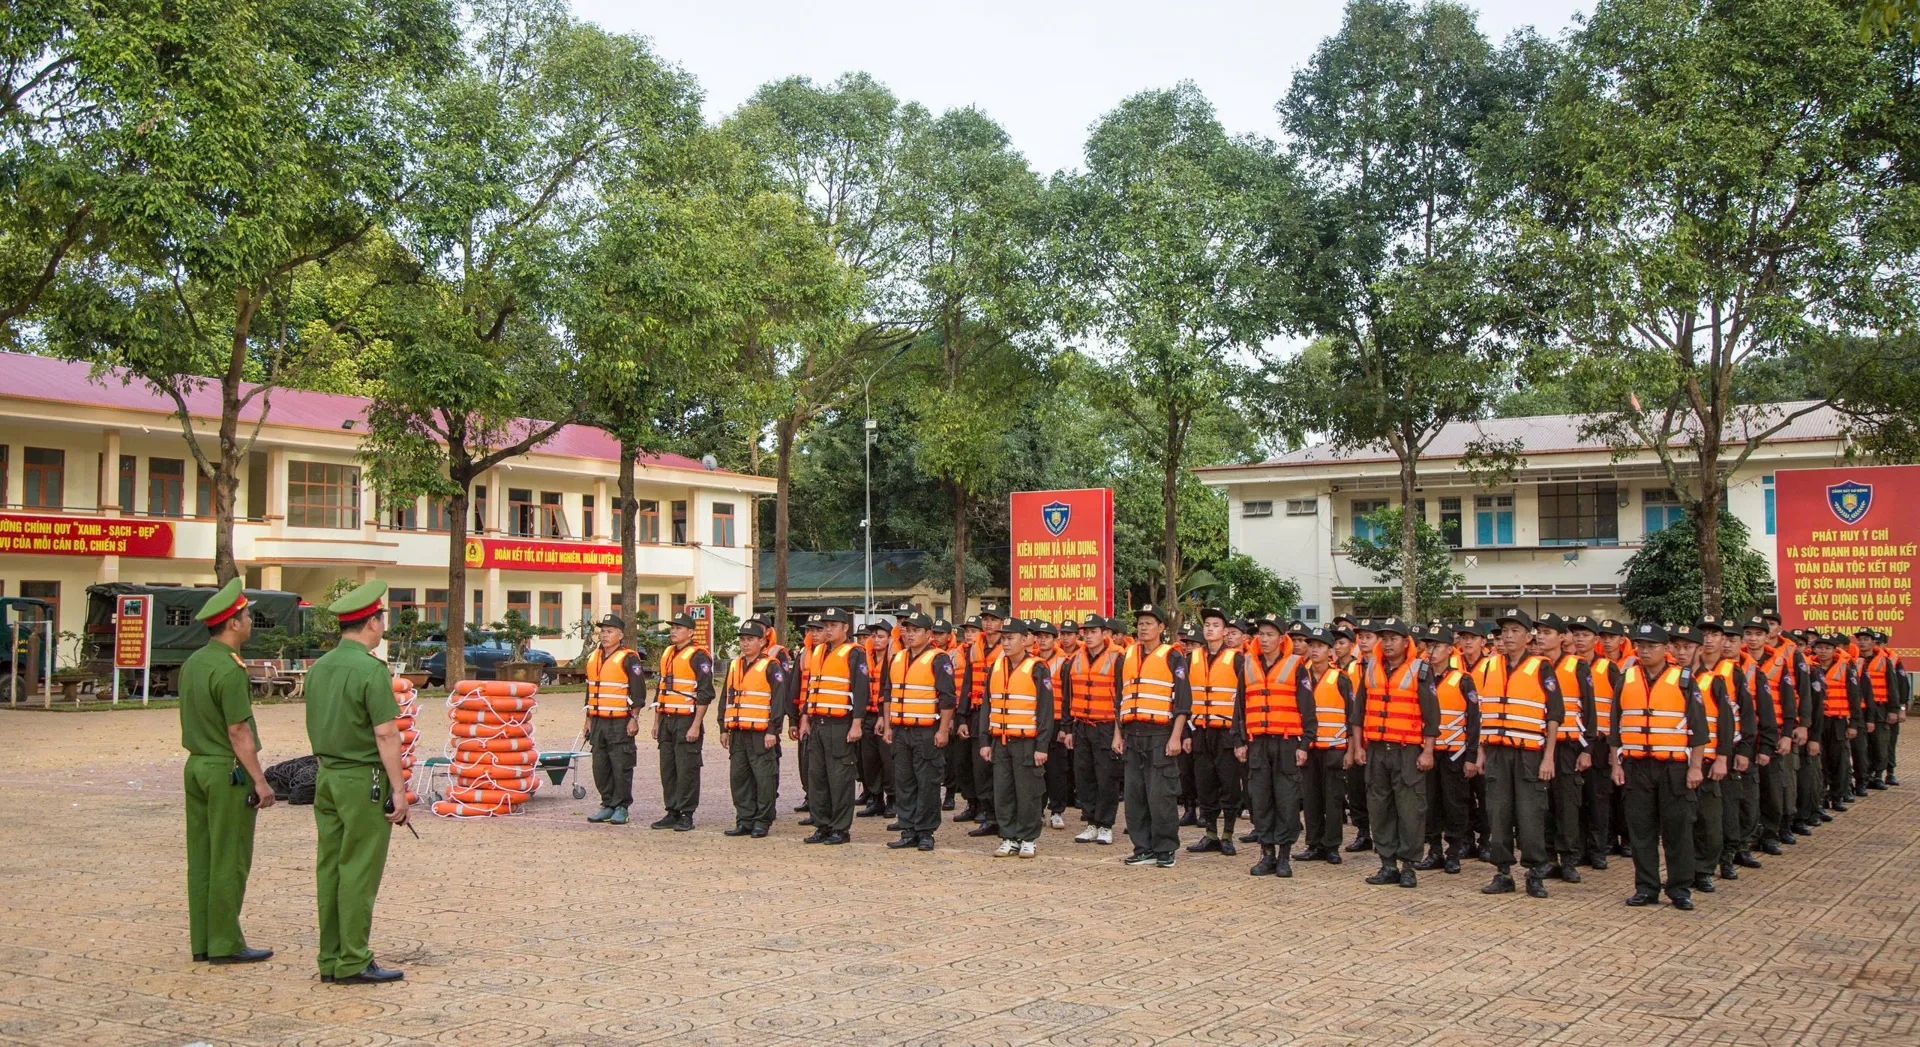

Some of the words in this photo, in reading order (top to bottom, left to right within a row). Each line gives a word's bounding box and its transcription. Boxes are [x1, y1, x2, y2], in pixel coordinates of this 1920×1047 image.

[24, 520, 51, 533] CHÍNH
[54, 523, 71, 535] QUY
[109, 525, 131, 539] SẠCH
[1812, 529, 1837, 542] PHÁT
[1839, 530, 1860, 541] HUY
[1862, 528, 1869, 541] Ý
[1871, 528, 1889, 541] CHÍ
[13, 534, 31, 549] CỦA
[53, 537, 72, 550] CÁN
[73, 537, 88, 553] BỘ,
[90, 538, 116, 552] CHIẾN
[1017, 540, 1032, 556] KIÊN
[1034, 542, 1051, 559] ĐỊNH
[1051, 539, 1061, 556] VÀ
[1062, 539, 1076, 559] VẬN
[1077, 540, 1099, 558] DỤNG,
[1786, 546, 1799, 558] VÀ
[1801, 545, 1819, 557] SỨC
[1822, 548, 1850, 560] MẠNH
[1852, 547, 1869, 559] ĐẠI
[1870, 543, 1898, 557] ĐOÀN
[1899, 542, 1917, 557] KẾT
[1019, 562, 1037, 579] PHÁT
[1060, 561, 1081, 578] SÁNG
[1082, 563, 1096, 581] TẠO
[1794, 561, 1821, 573] TOÀN
[1822, 560, 1844, 573] DÂN
[1846, 560, 1865, 575] TỘC
[1868, 559, 1886, 573] KẾT
[1889, 561, 1911, 575] HỢP
[1019, 583, 1033, 601] CHỦ
[1056, 584, 1072, 601] MÁC
[1795, 576, 1811, 589] VỚI
[1813, 576, 1833, 589] SỨC
[1836, 578, 1866, 591] MẠNH
[1868, 576, 1891, 589] THỜI
[1893, 577, 1912, 590] ĐẠI
[1810, 592, 1829, 605] XÂY
[1831, 594, 1859, 607] DỰNG
[1860, 592, 1875, 604] VÀ
[1876, 590, 1897, 604] BẢO
[1898, 592, 1912, 607] VỆ
[1803, 609, 1830, 620] VỮNG
[1832, 606, 1859, 620] CHẮC
[1876, 606, 1905, 621] QUỐC
